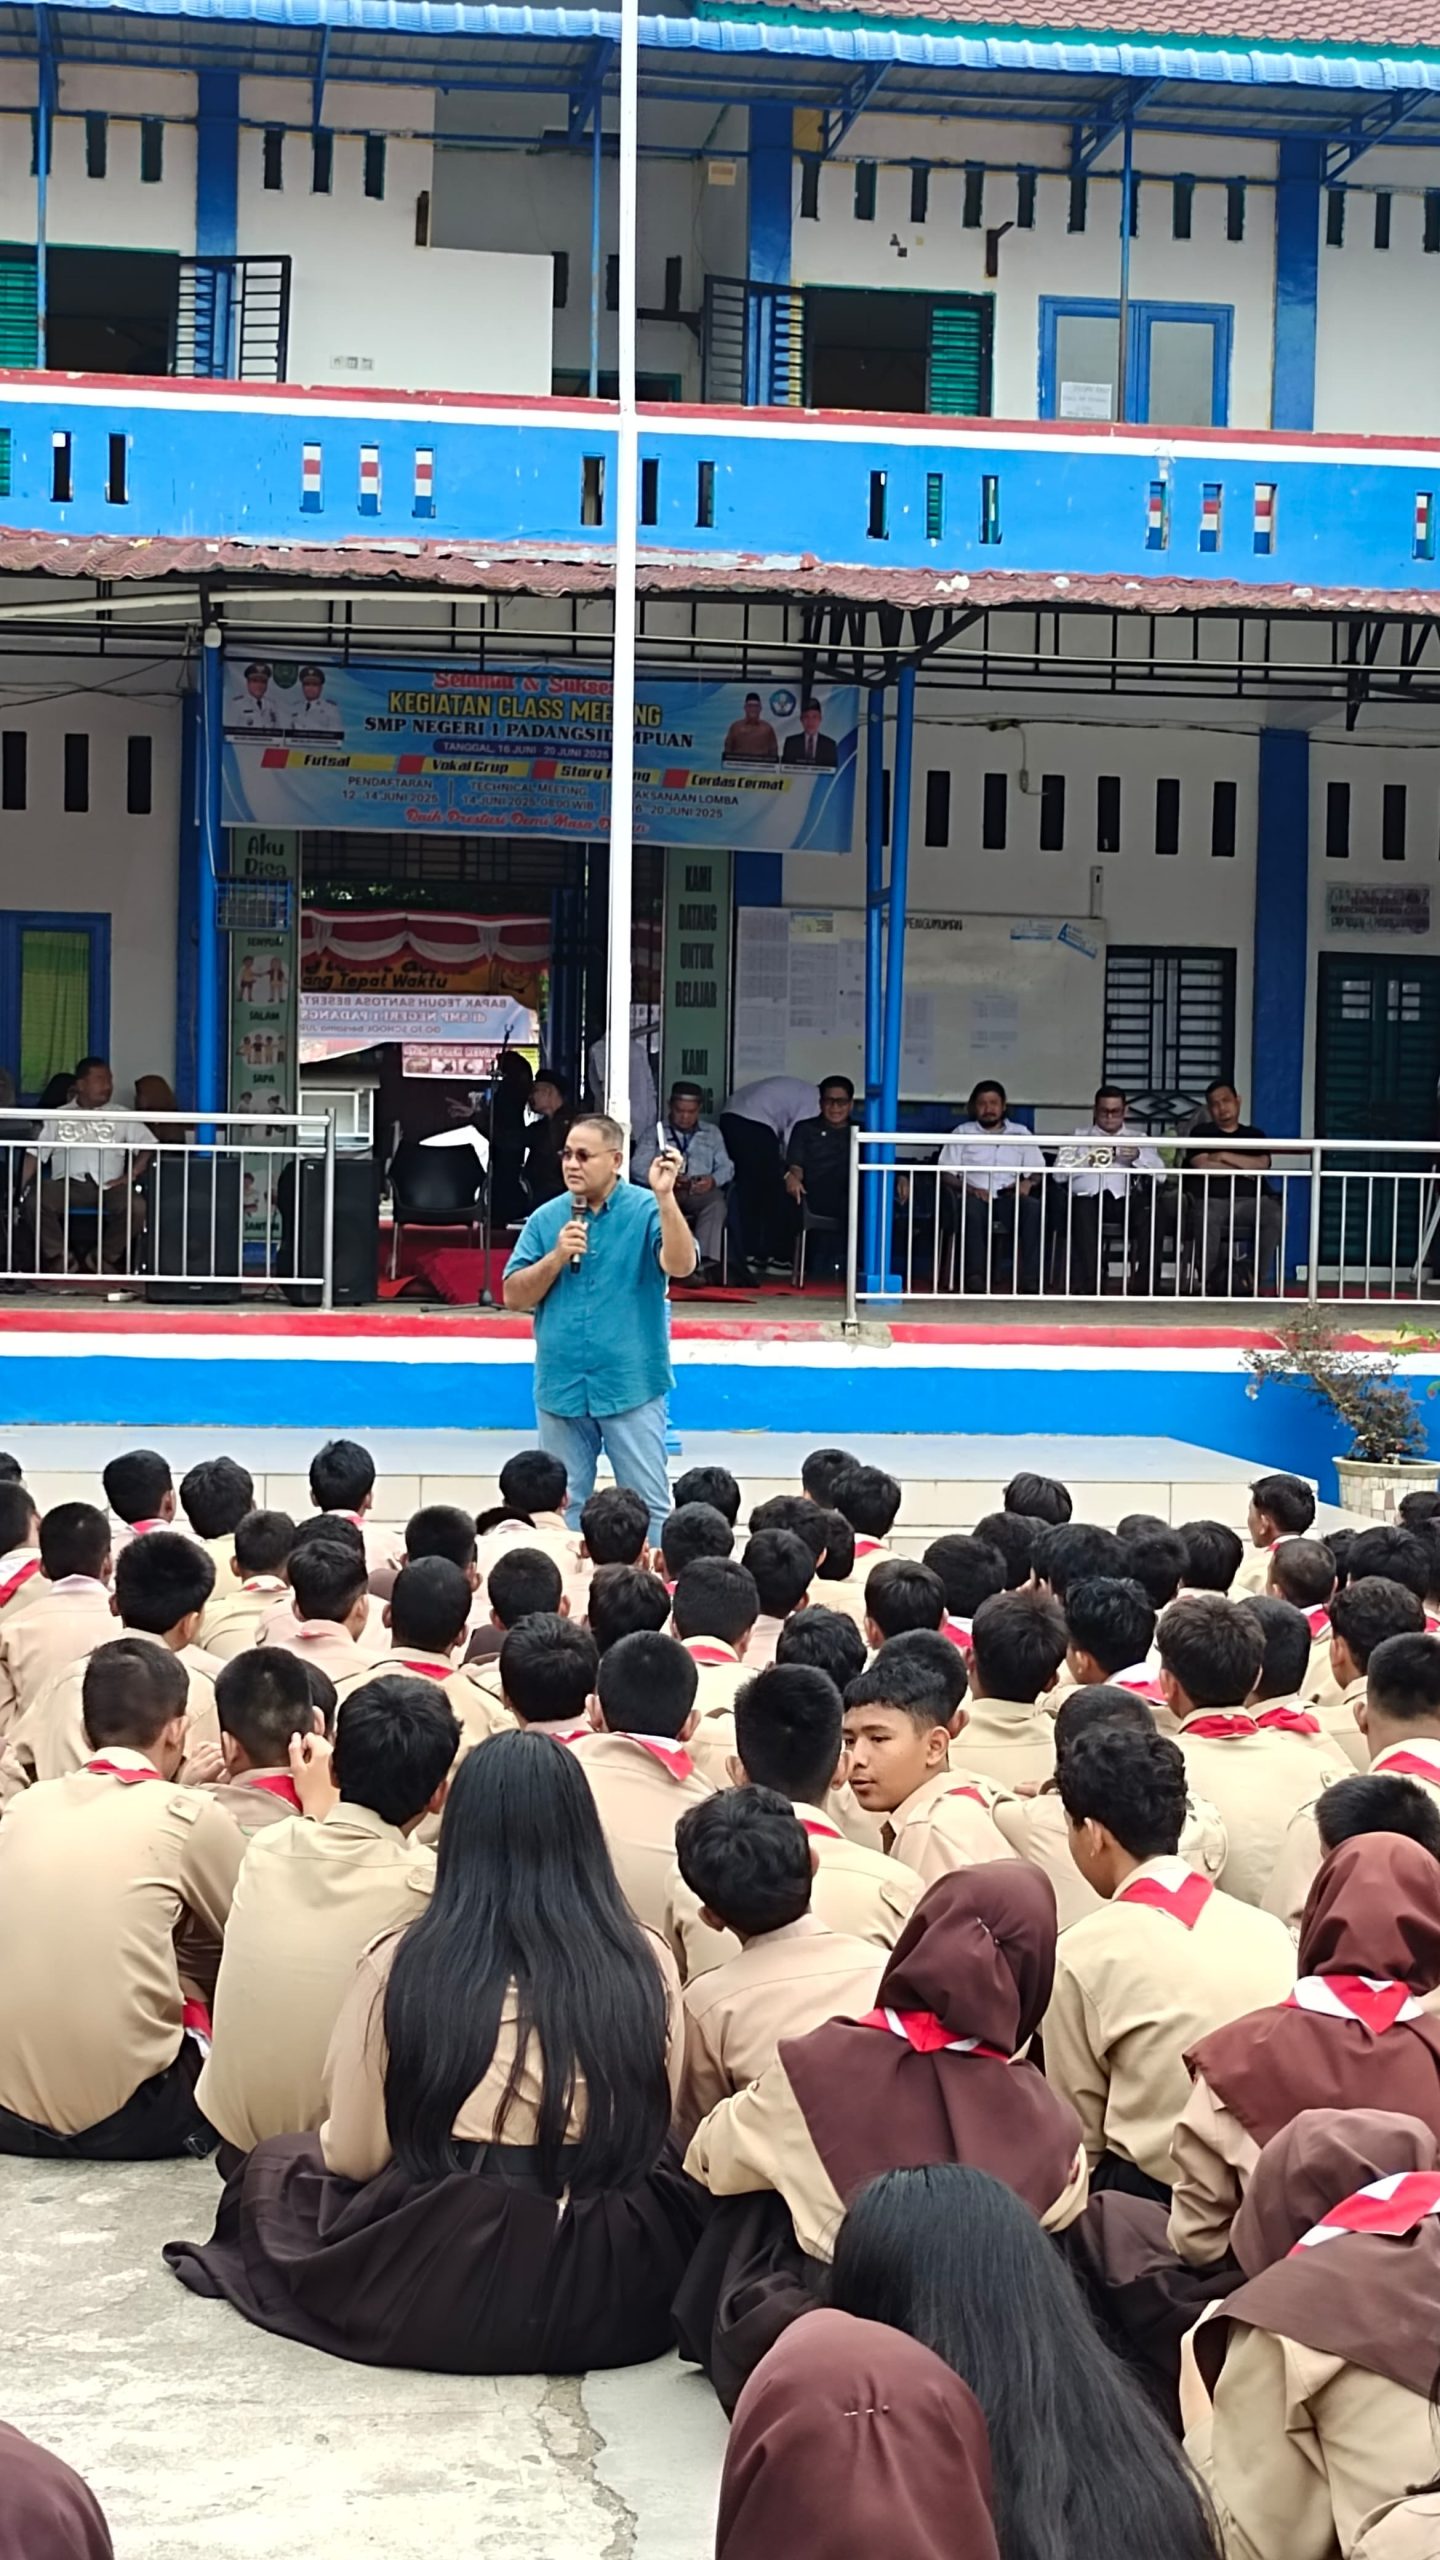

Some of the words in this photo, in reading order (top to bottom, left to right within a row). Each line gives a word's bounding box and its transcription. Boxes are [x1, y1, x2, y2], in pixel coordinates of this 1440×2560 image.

[548, 677, 614, 695] Sukse
[389, 691, 491, 717] KEGIATAN
[497, 696, 563, 720] CLASS
[570, 700, 662, 728] MEENG
[365, 717, 406, 732] SMP
[413, 719, 484, 736] NEGERI
[492, 723, 498, 737] 1
[506, 724, 693, 747] PADANGSIDPUAN
[512, 745, 537, 755] JUNI
[543, 746, 556, 756] 20
[557, 748, 582, 758] JUNI
[584, 749, 609, 759] 2025
[303, 754, 351, 767] Futsal
[432, 759, 471, 771] Vokal
[473, 761, 509, 775] Grup
[561, 765, 604, 781] Story
[348, 776, 433, 789] PENDAFTARAN
[471, 781, 533, 793] TECHNICAL
[538, 784, 587, 796] MEETING
[691, 774, 735, 787] Cerdas
[737, 776, 784, 791] Cermat
[343, 790, 355, 800] 12
[365, 791, 377, 801] 14
[382, 792, 408, 802] JUNI
[411, 793, 438, 803] 2025
[479, 796, 505, 806] JUNI
[635, 790, 696, 802] AKSANAAN
[699, 795, 739, 806] LOMBA
[651, 805, 664, 815] 20
[667, 806, 692, 816] JUNI
[695, 808, 723, 818] 2025
[553, 813, 593, 830] Masa
[248, 833, 284, 856] Aku
[685, 865, 712, 892] KAMI
[678, 904, 717, 931] DATANG
[680, 942, 714, 970] UNTUK
[339, 973, 388, 990] Tepat
[392, 974, 448, 989] Waktu
[675, 981, 717, 1008] BELAJAR
[249, 1011, 280, 1021] SALAM
[682, 1049, 708, 1076] KAMI
[252, 1073, 275, 1083] SAPA
[244, 1221, 279, 1232] SANTN
